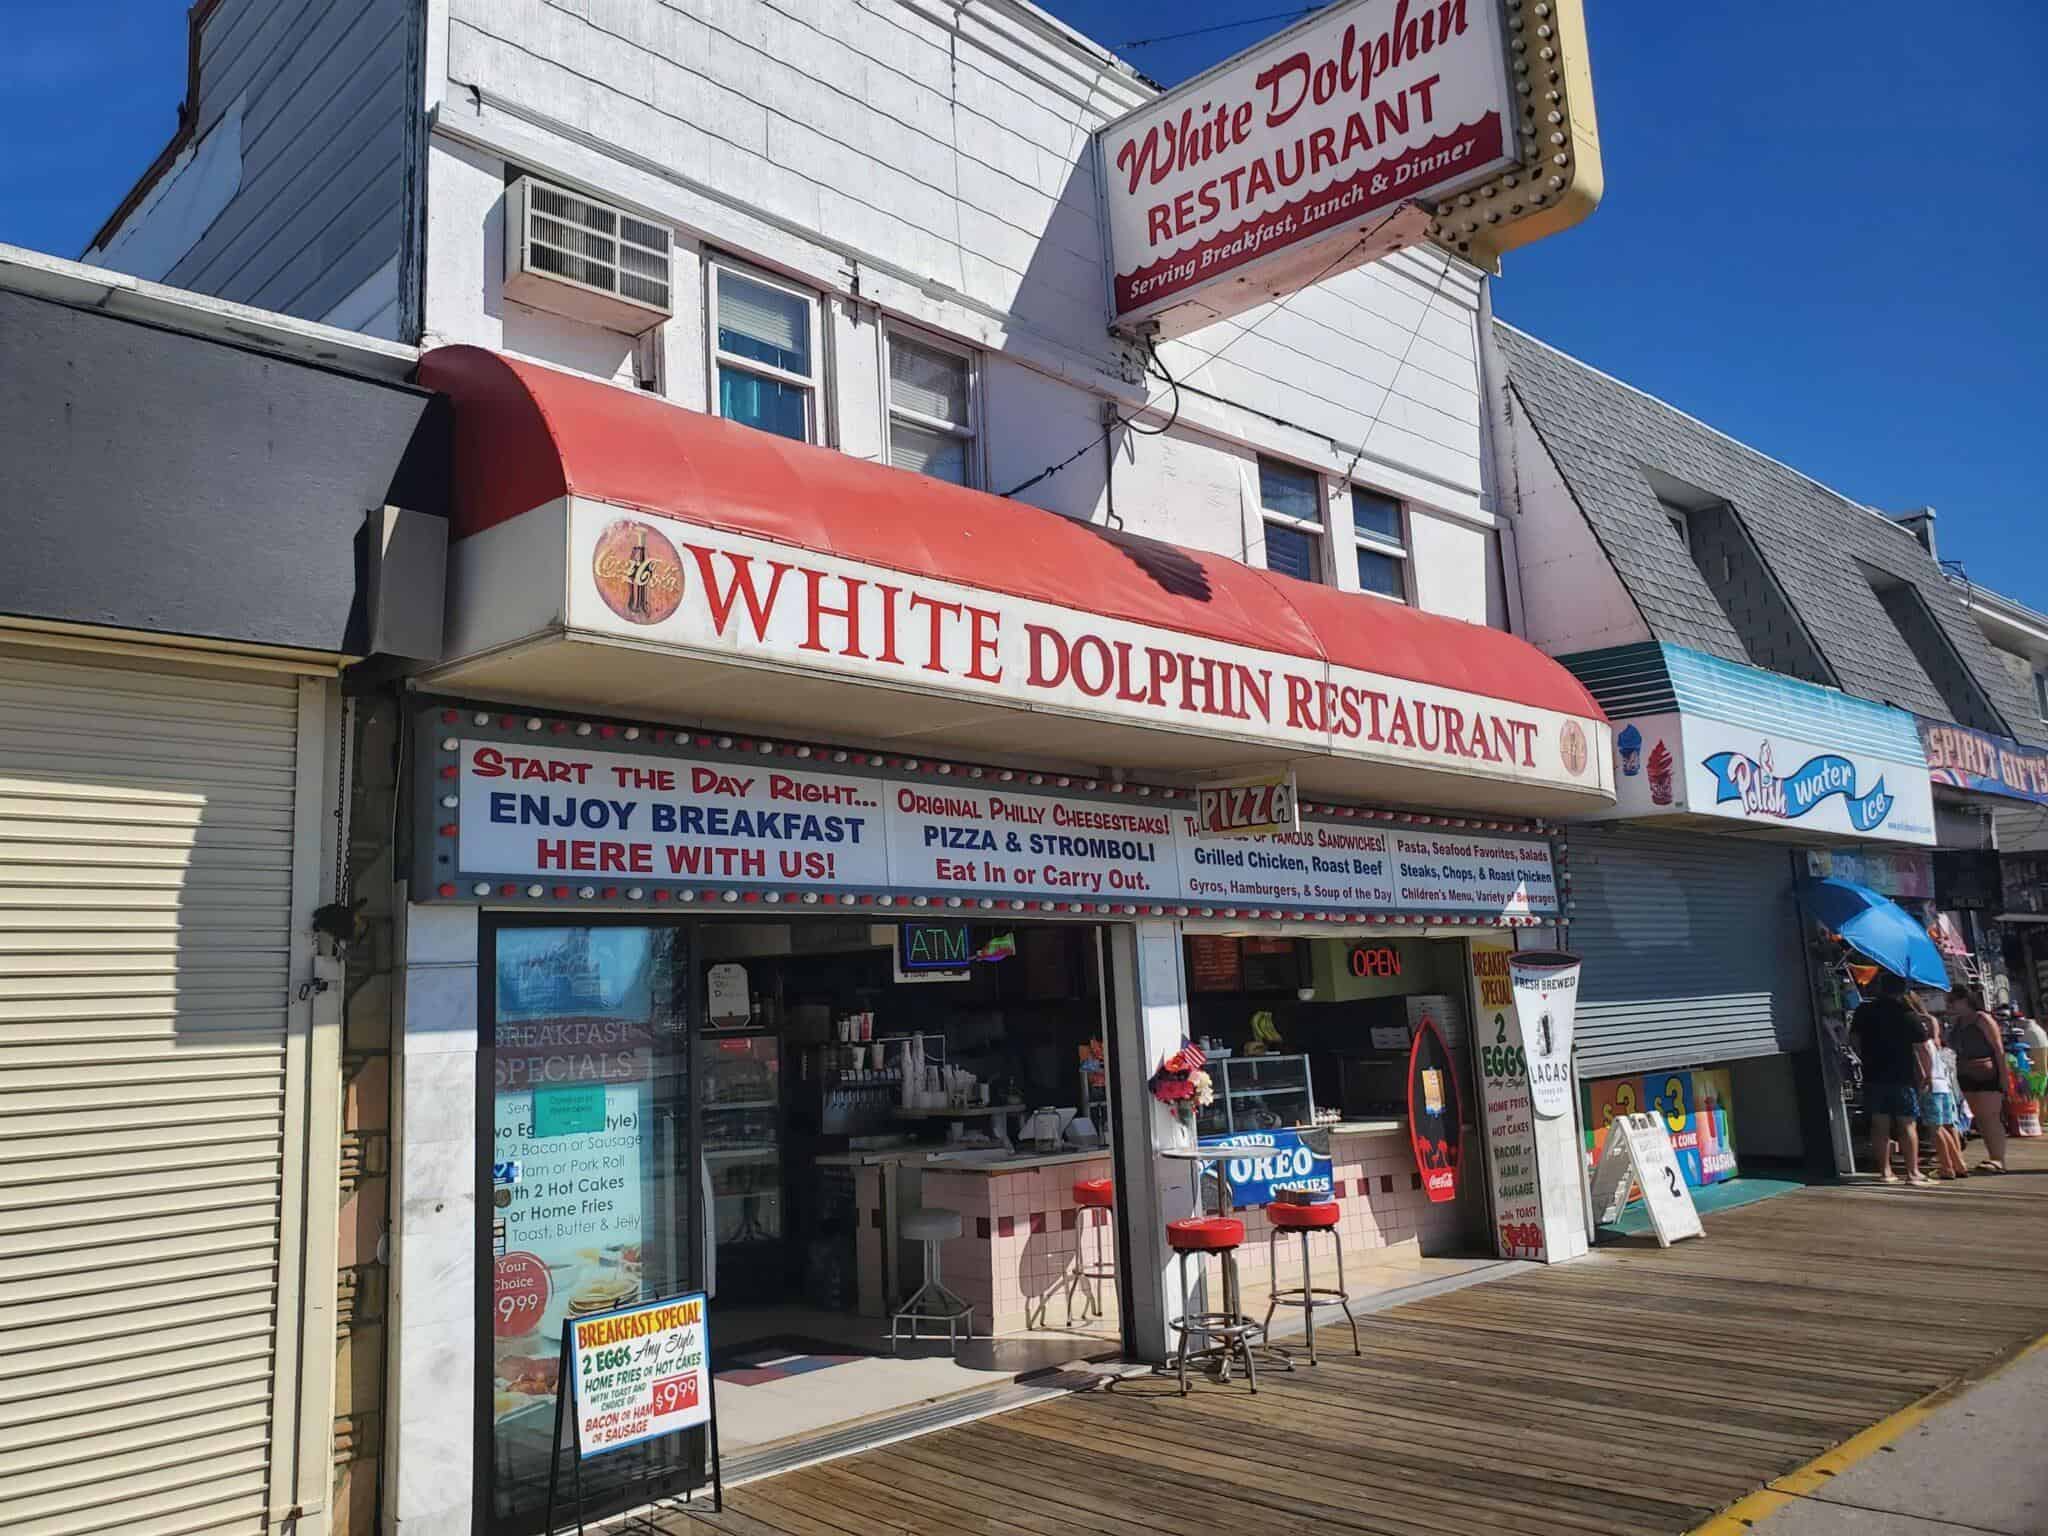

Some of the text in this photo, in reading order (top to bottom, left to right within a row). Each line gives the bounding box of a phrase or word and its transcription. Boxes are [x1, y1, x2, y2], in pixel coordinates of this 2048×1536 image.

[1116, 0, 1469, 195] White Dolphin
[1147, 74, 1441, 247] RESTAURANT
[1129, 137, 1477, 299] Serving Breakfast, Lunch & Dinner
[682, 542, 1539, 768] WHITE DOLPHIN RESTAURANT
[1928, 726, 1999, 780] SPIRIT
[472, 747, 593, 784] START
[611, 767, 676, 792] THE
[691, 767, 756, 799] DAY
[1727, 752, 1853, 816] Polish water
[489, 791, 866, 844] ENJOY BREAKFAST
[896, 788, 1171, 837] ORIGINAL PHILLY CHEESESTEAKS!
[1200, 784, 1293, 832] PIZZA
[1862, 791, 1886, 827] Ice
[923, 825, 1156, 863] PIZZA & STROMBOLI
[1183, 816, 1201, 838] TH
[1318, 828, 1387, 853] SANDWICHES!
[537, 838, 836, 880] HERE WITH US!
[1194, 847, 1383, 876] Grilled Chicken, Roast Beef
[1397, 839, 1549, 863] Pasta, Seafood Favorites, Salads
[935, 858, 1151, 893] Eat In or Carry Out.
[1400, 863, 1552, 884] Steaks, Chops, & Roast Chicken
[1189, 878, 1393, 904] Gyros, Hamburgers, & Soup of the Day
[1401, 887, 1448, 901] Children's
[1448, 889, 1475, 903] Menu,
[1475, 890, 1506, 905] Variety
[910, 927, 967, 960] ATM
[1352, 947, 1401, 978] OPEN
[1514, 975, 1576, 991] FRESH BREWED
[495, 1021, 630, 1047] BREAKFAST
[1495, 1012, 1507, 1044] 2
[495, 1050, 636, 1085] SPECIALS
[1482, 1045, 1526, 1078] EGGS
[1530, 1063, 1569, 1085] LACAS
[1487, 1099, 1508, 1113] HOME
[1509, 1096, 1530, 1110] FRIES
[606, 1112, 638, 1131] tyle)
[1491, 1121, 1529, 1137] HOT CAKES
[509, 1146, 519, 1158] 2
[521, 1140, 567, 1157] Bacon
[570, 1141, 585, 1152] or
[588, 1133, 643, 1151] Sausage
[1232, 1133, 1275, 1147] FRIED
[552, 1162, 567, 1175] or
[570, 1158, 600, 1173] Pork
[602, 1154, 625, 1169] Roll
[1229, 1147, 1314, 1184] OREO
[510, 1176, 625, 1201] ith 2 Hot Cakes
[509, 1198, 614, 1223] or Home Fries
[512, 1214, 642, 1243] Toast, Butter & Jelly
[494, 1275, 535, 1290] Choice
[498, 1261, 528, 1274] Your
[578, 1300, 702, 1350] BREAKFAST SPECIAL
[583, 1328, 695, 1375] 2 EGGS Any Style
[585, 1374, 615, 1393] HOME
[616, 1367, 642, 1386] FRIES
[655, 1358, 675, 1377] HOT
[675, 1351, 702, 1370] CAKES
[590, 1391, 609, 1406] WITH
[611, 1385, 632, 1399] TOAST
[585, 1411, 620, 1433] BACON
[633, 1403, 654, 1420] HAM
[605, 1420, 649, 1442] SAUSAGE
